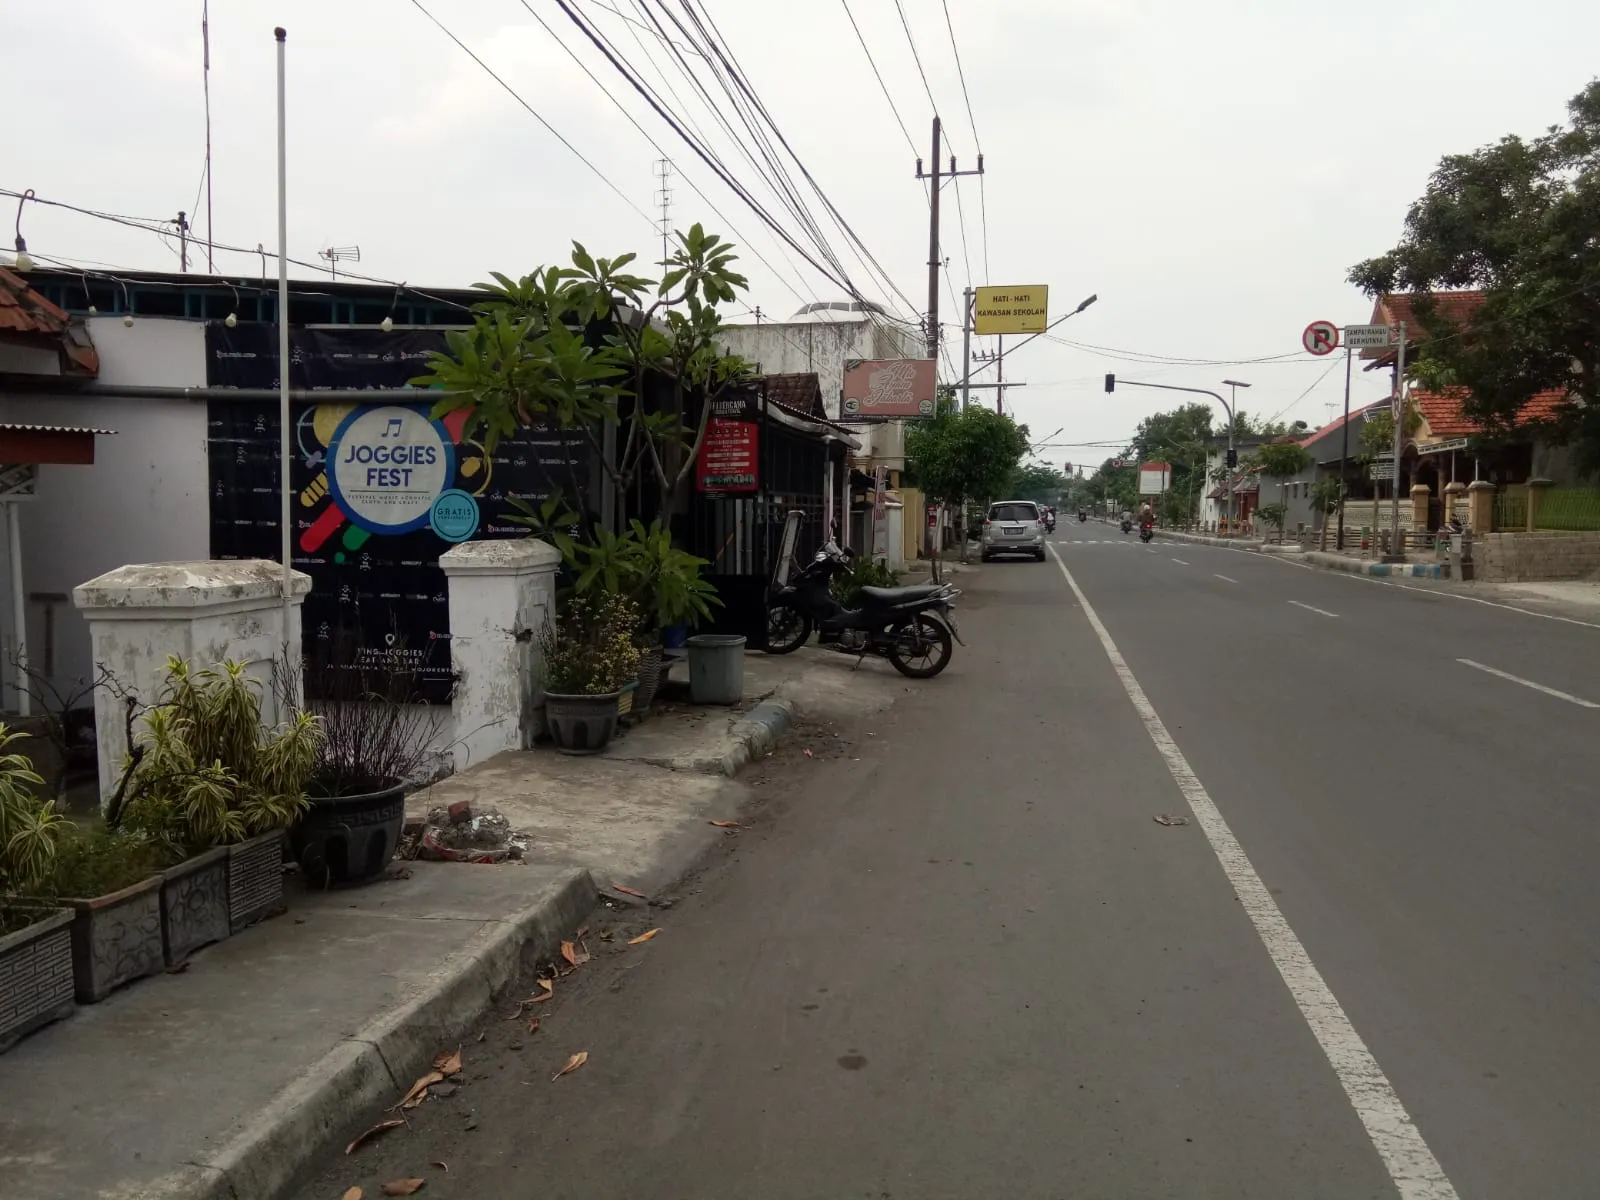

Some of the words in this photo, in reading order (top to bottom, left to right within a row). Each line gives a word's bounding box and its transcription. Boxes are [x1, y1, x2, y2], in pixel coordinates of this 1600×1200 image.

[977, 309, 1011, 317] KAWASAN
[1012, 308, 1045, 316] SEKOLAH
[344, 445, 437, 465] JOGGIES
[366, 468, 413, 487] FEST
[437, 508, 472, 516] GRATIS
